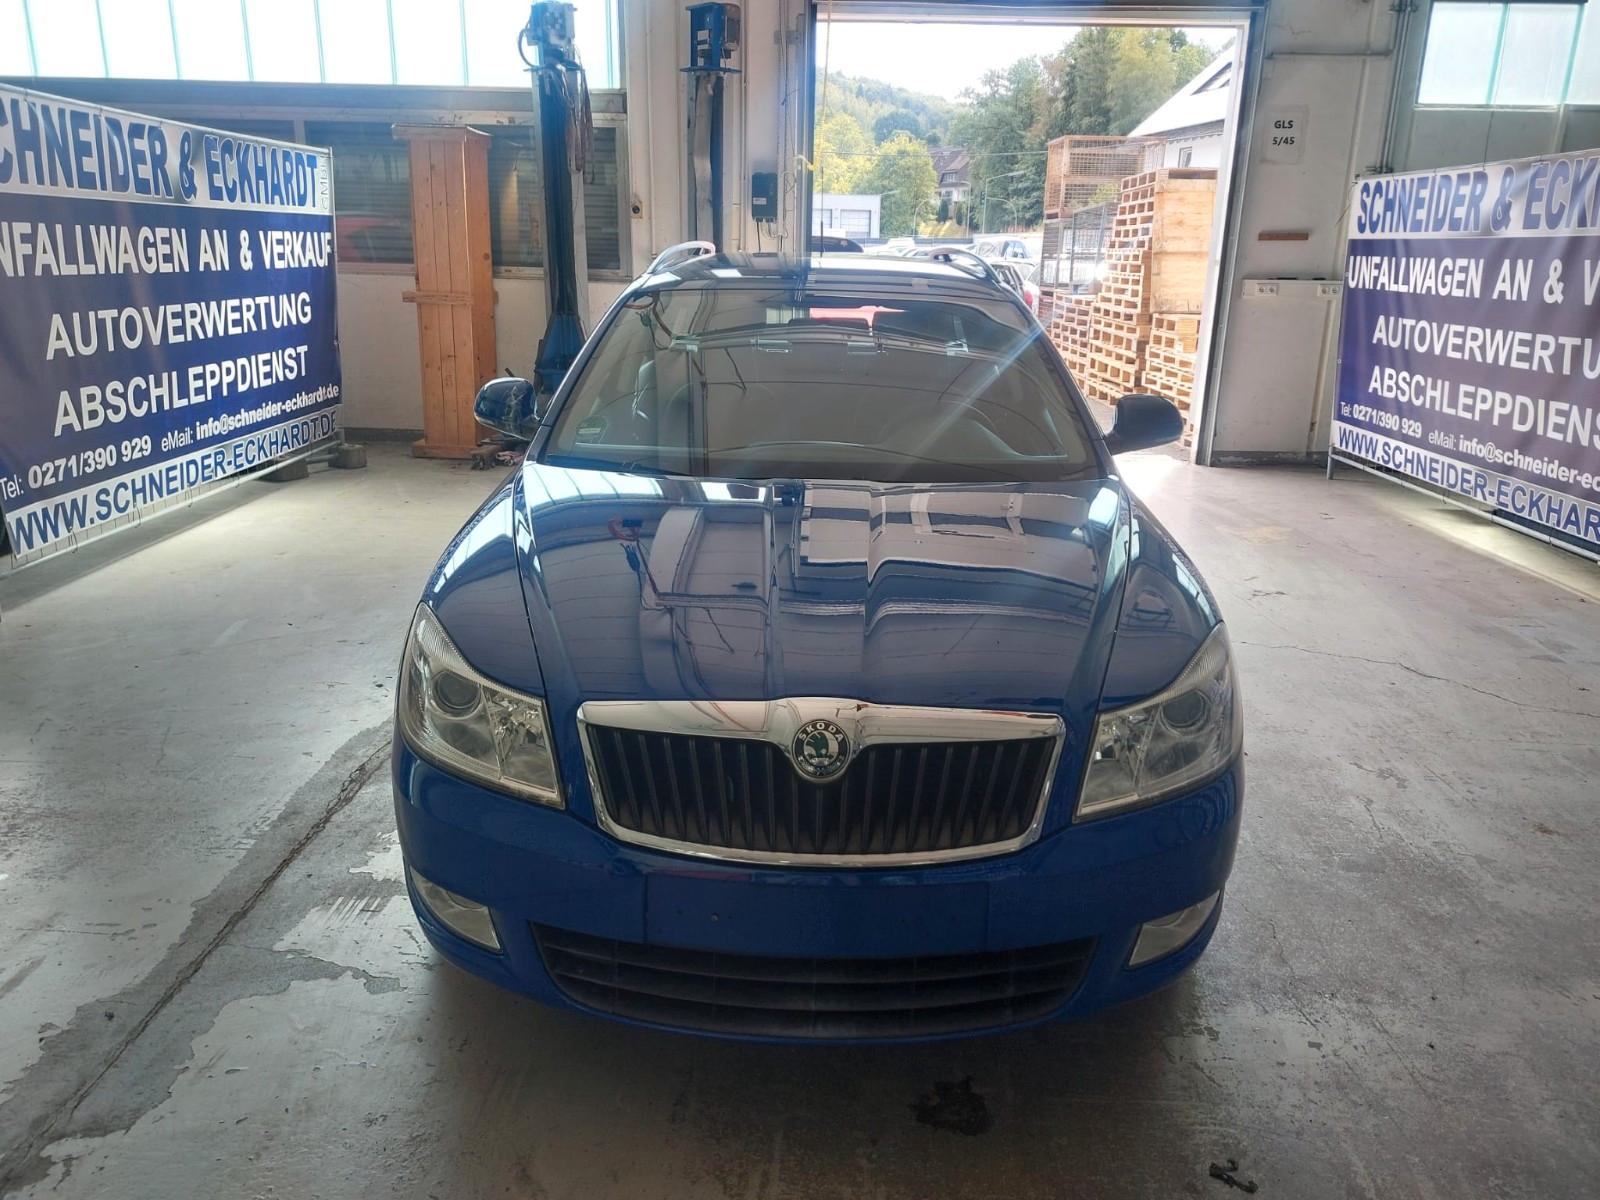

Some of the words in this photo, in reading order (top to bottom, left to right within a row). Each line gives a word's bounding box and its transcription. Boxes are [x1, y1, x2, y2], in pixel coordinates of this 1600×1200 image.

[1272, 136, 1295, 146] 5/45
[1274, 120, 1294, 129] GLS
[179, 131, 197, 201] &
[203, 135, 318, 208] ECKHARDT
[1357, 170, 1489, 234] SCHNEIDER
[1492, 166, 1516, 231] &
[199, 229, 231, 273] AN
[239, 229, 253, 271] &
[259, 230, 332, 269] VERKAUF
[1348, 256, 1484, 299] UNFALLWAGEN
[1492, 258, 1534, 302] AN
[1543, 258, 1565, 305] &
[46, 291, 312, 361] AUTOVERWERTUNG
[54, 344, 309, 437] ABSCHLEPPDIENST
[1352, 403, 1400, 432] 0271/390
[1401, 417, 1422, 439] 929
[1428, 430, 1457, 452] eMail:
[0, 475, 24, 501] Tel:
[28, 444, 117, 490] 0271/390
[121, 434, 152, 461] 929
[161, 429, 194, 453] eMail:
[8, 410, 337, 556] WWW.SCHNEIDER-ECKHARDT.DE
